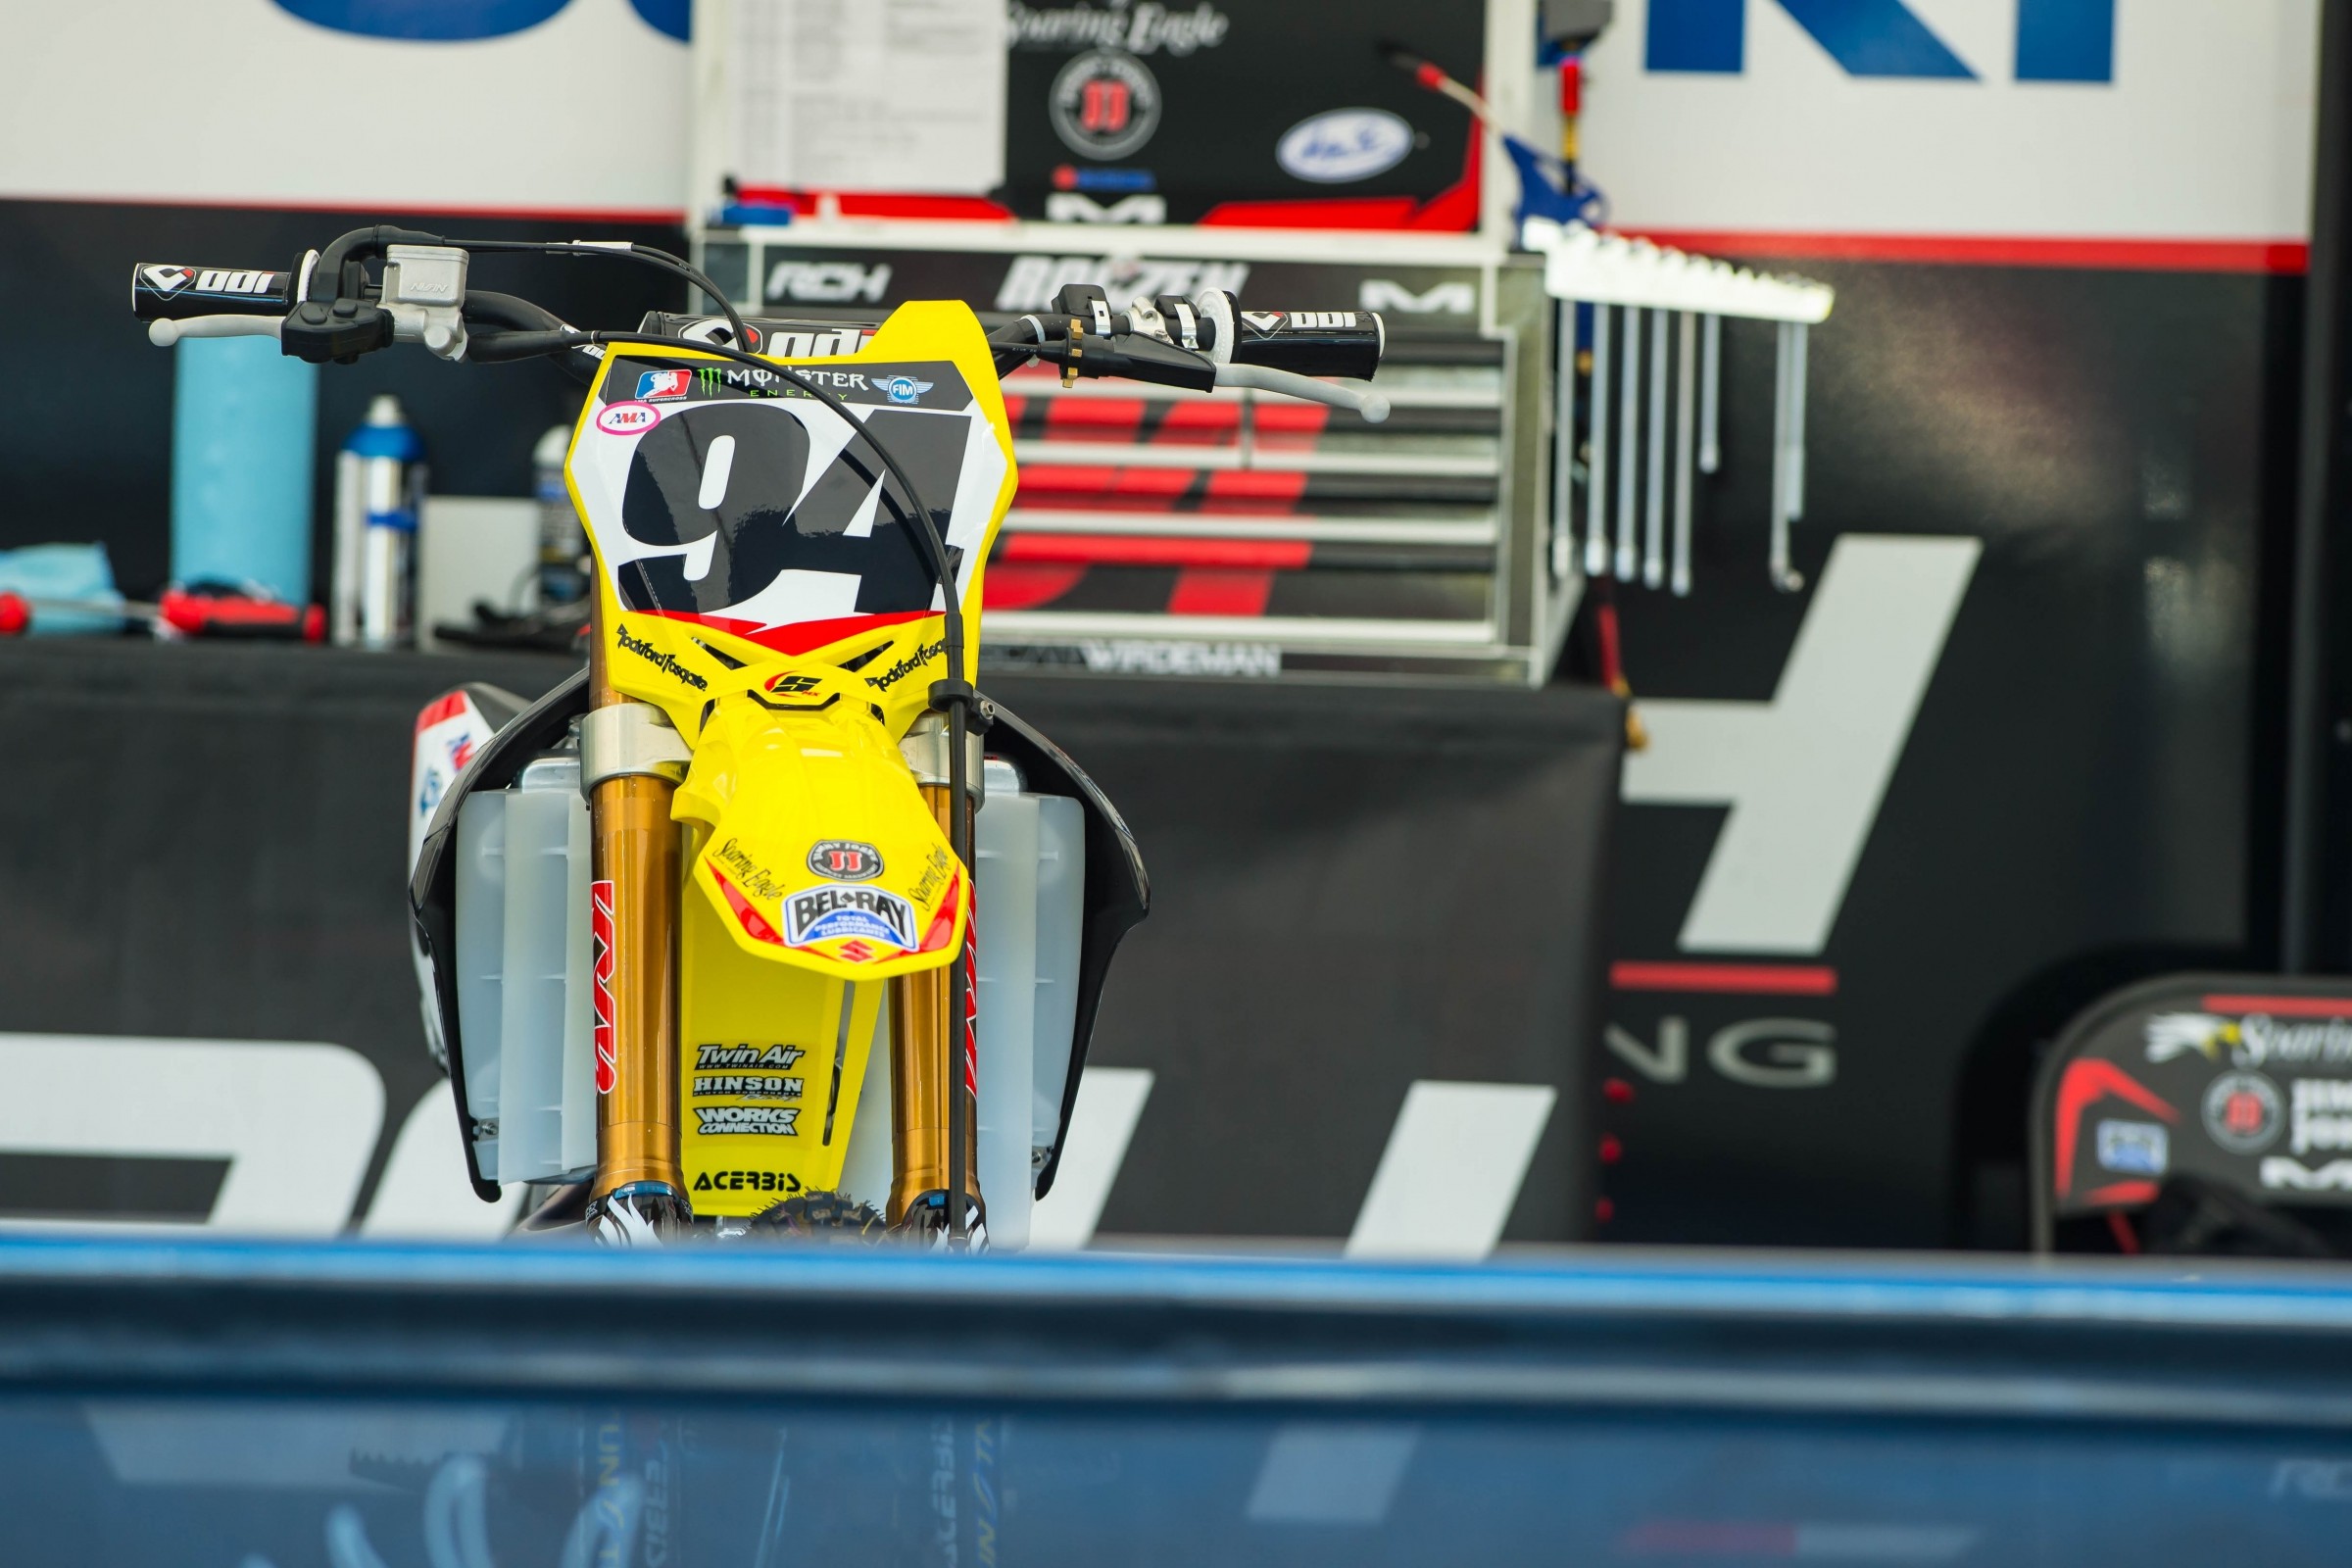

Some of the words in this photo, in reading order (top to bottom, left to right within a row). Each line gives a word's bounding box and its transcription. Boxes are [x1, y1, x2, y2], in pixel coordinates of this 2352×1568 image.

[750, 389, 848, 401] ENERY
[893, 383, 913, 396] FIM
[608, 412, 646, 424] AMA
[618, 403, 972, 615] 94
[699, 1045, 760, 1064] Twin
[758, 1044, 804, 1064] Air
[694, 1076, 804, 1091] HINSON
[696, 1107, 800, 1124] WORKS
[699, 1122, 796, 1136] CONNECTION
[693, 1171, 802, 1193] ACERBIS
